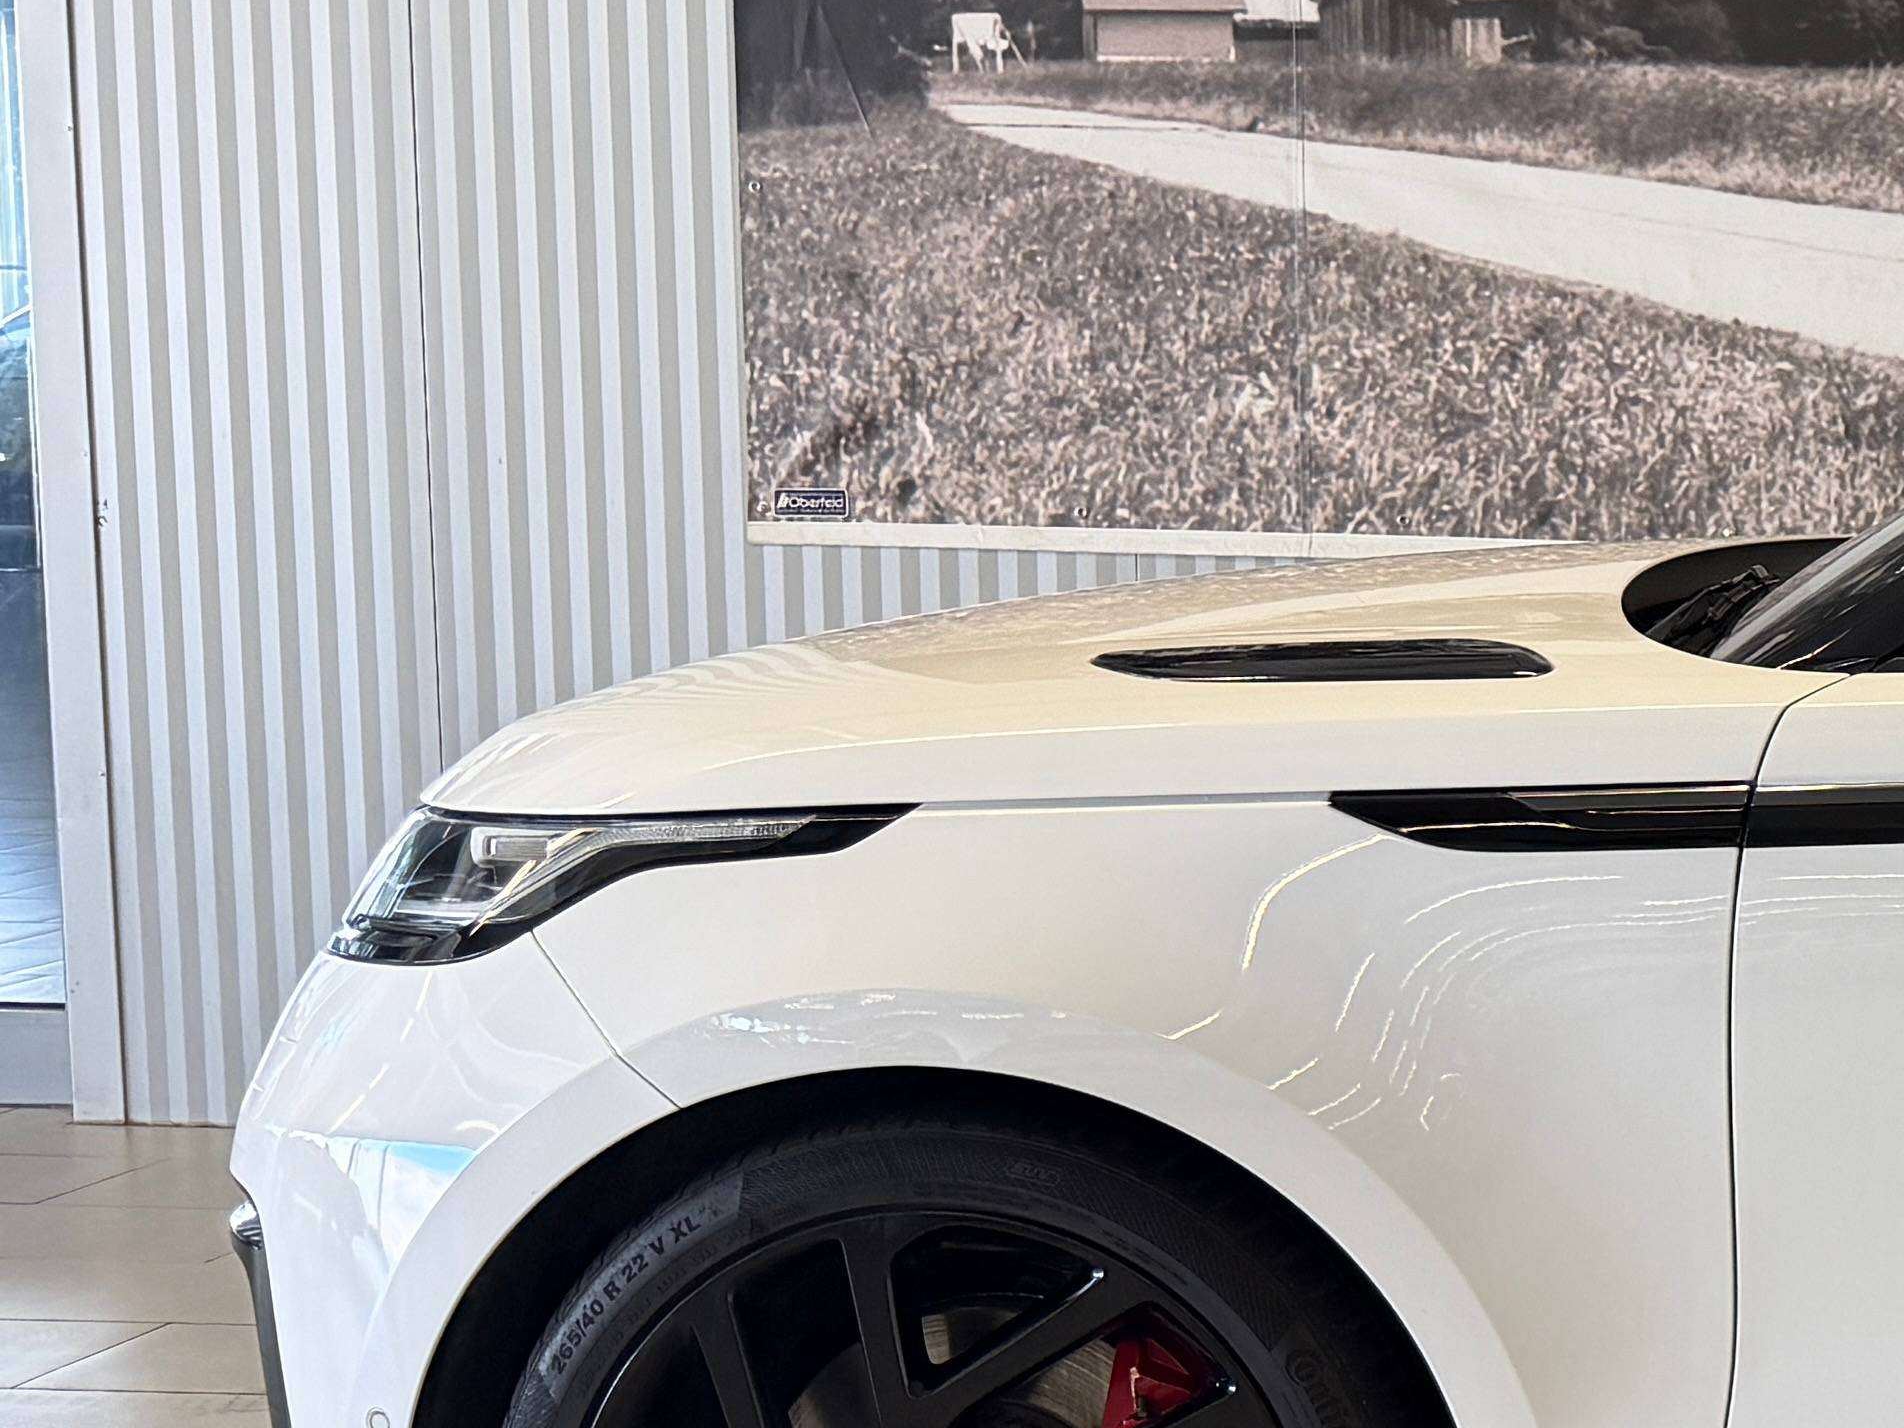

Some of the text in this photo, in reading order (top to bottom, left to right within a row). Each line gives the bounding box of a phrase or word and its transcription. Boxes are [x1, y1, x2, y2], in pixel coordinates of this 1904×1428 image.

[551, 1299, 604, 1374] 265/40
[603, 1280, 621, 1301] R
[622, 1254, 649, 1283] 22
[650, 1236, 665, 1256] V
[669, 1216, 702, 1244] XL
